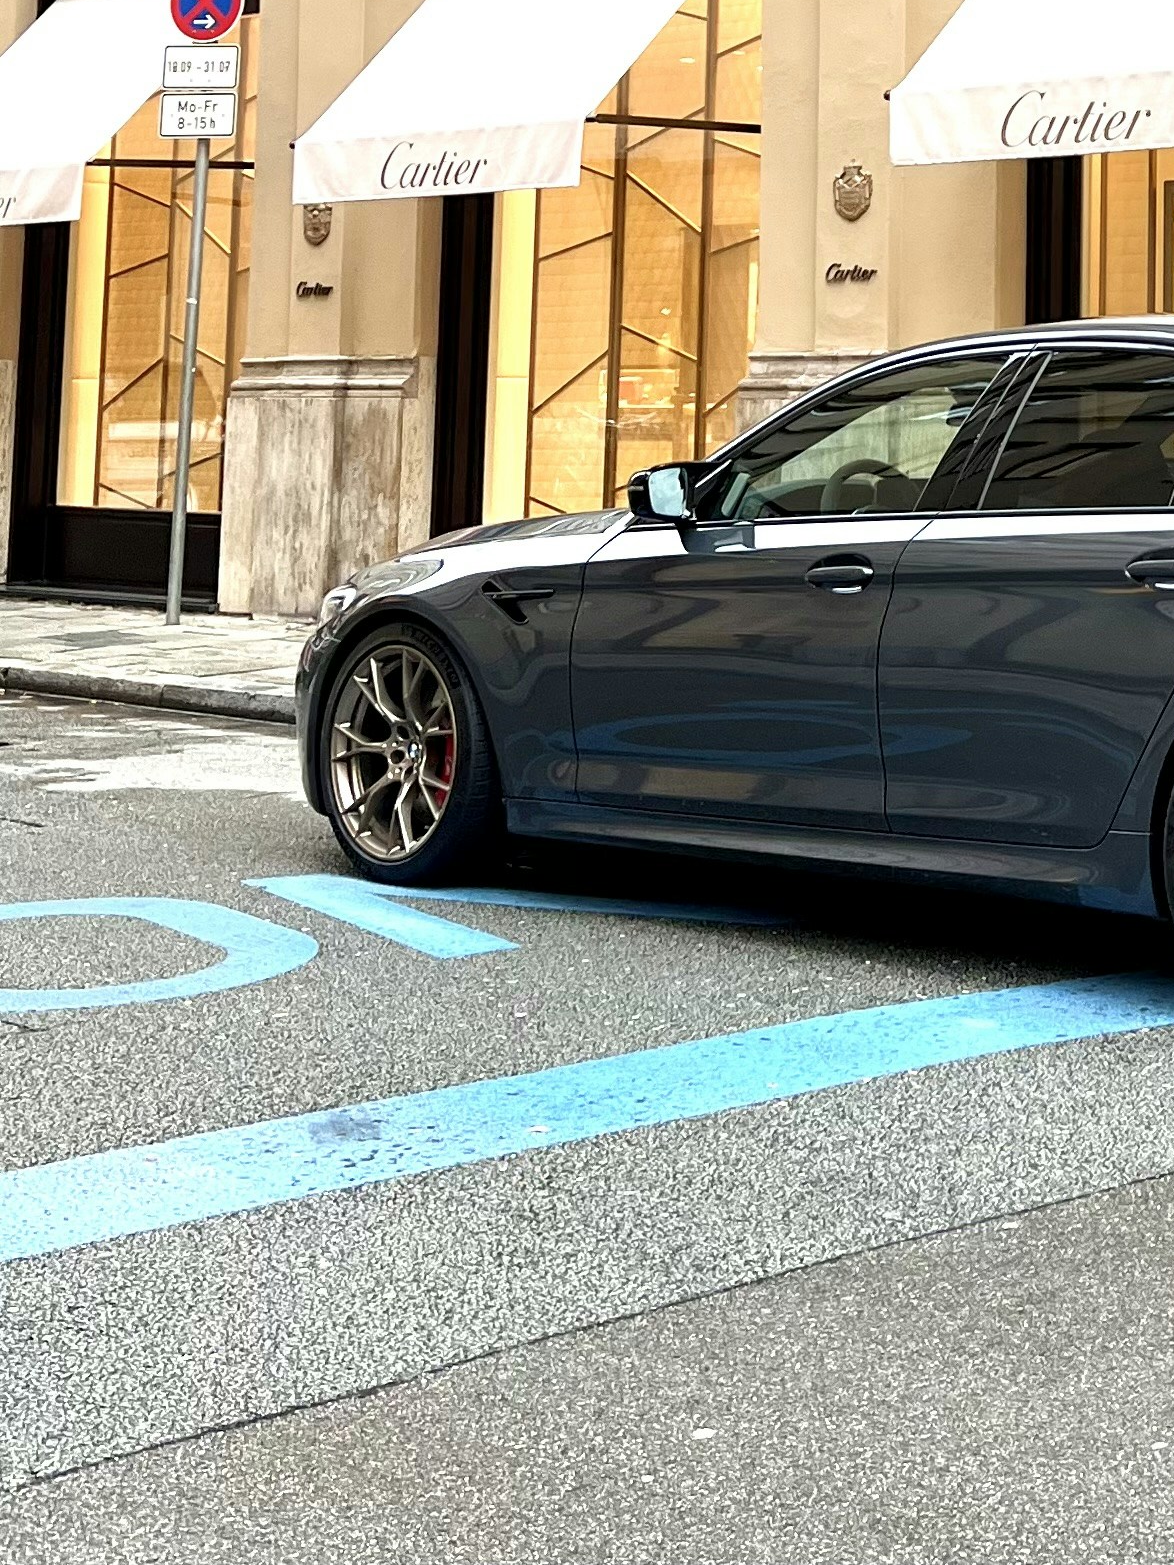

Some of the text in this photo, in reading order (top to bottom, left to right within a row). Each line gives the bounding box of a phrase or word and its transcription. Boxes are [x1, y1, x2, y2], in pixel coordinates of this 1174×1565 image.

[177, 99, 219, 113] Mo-Fr
[1001, 89, 1152, 148] Cartier
[380, 140, 488, 190] Cartier
[825, 262, 878, 284] Cartier
